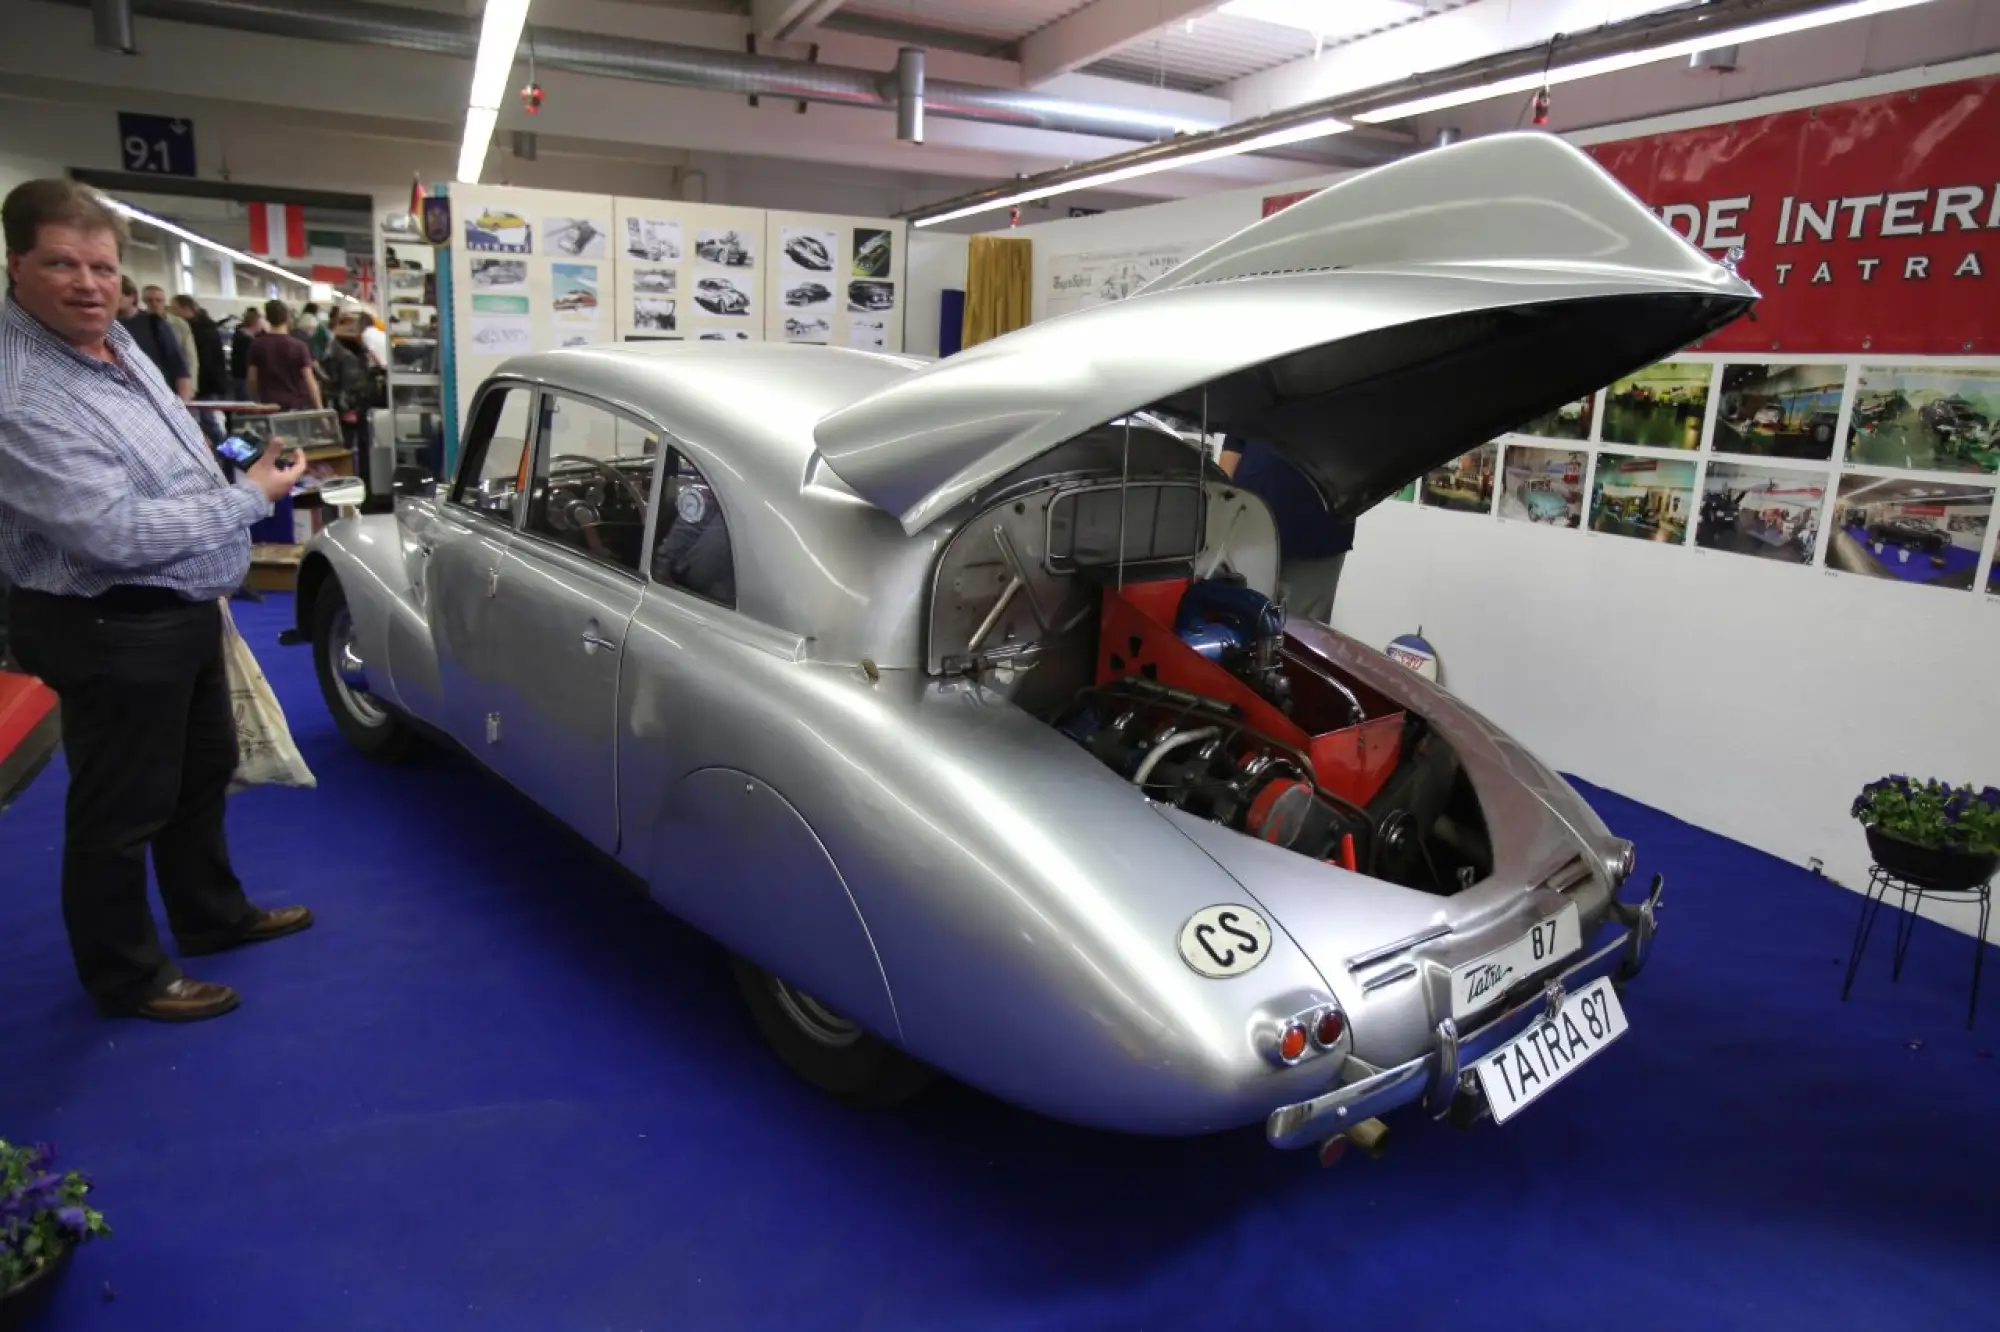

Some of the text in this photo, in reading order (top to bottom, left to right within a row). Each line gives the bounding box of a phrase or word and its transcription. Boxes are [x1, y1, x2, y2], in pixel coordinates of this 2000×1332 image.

[125, 136, 170, 173] 9.1
[1775, 252, 1982, 285] TATRA
[1195, 911, 1259, 967] CS
[1464, 919, 1556, 1004] Tatra 87
[1492, 986, 1611, 1102] TATRA 87
